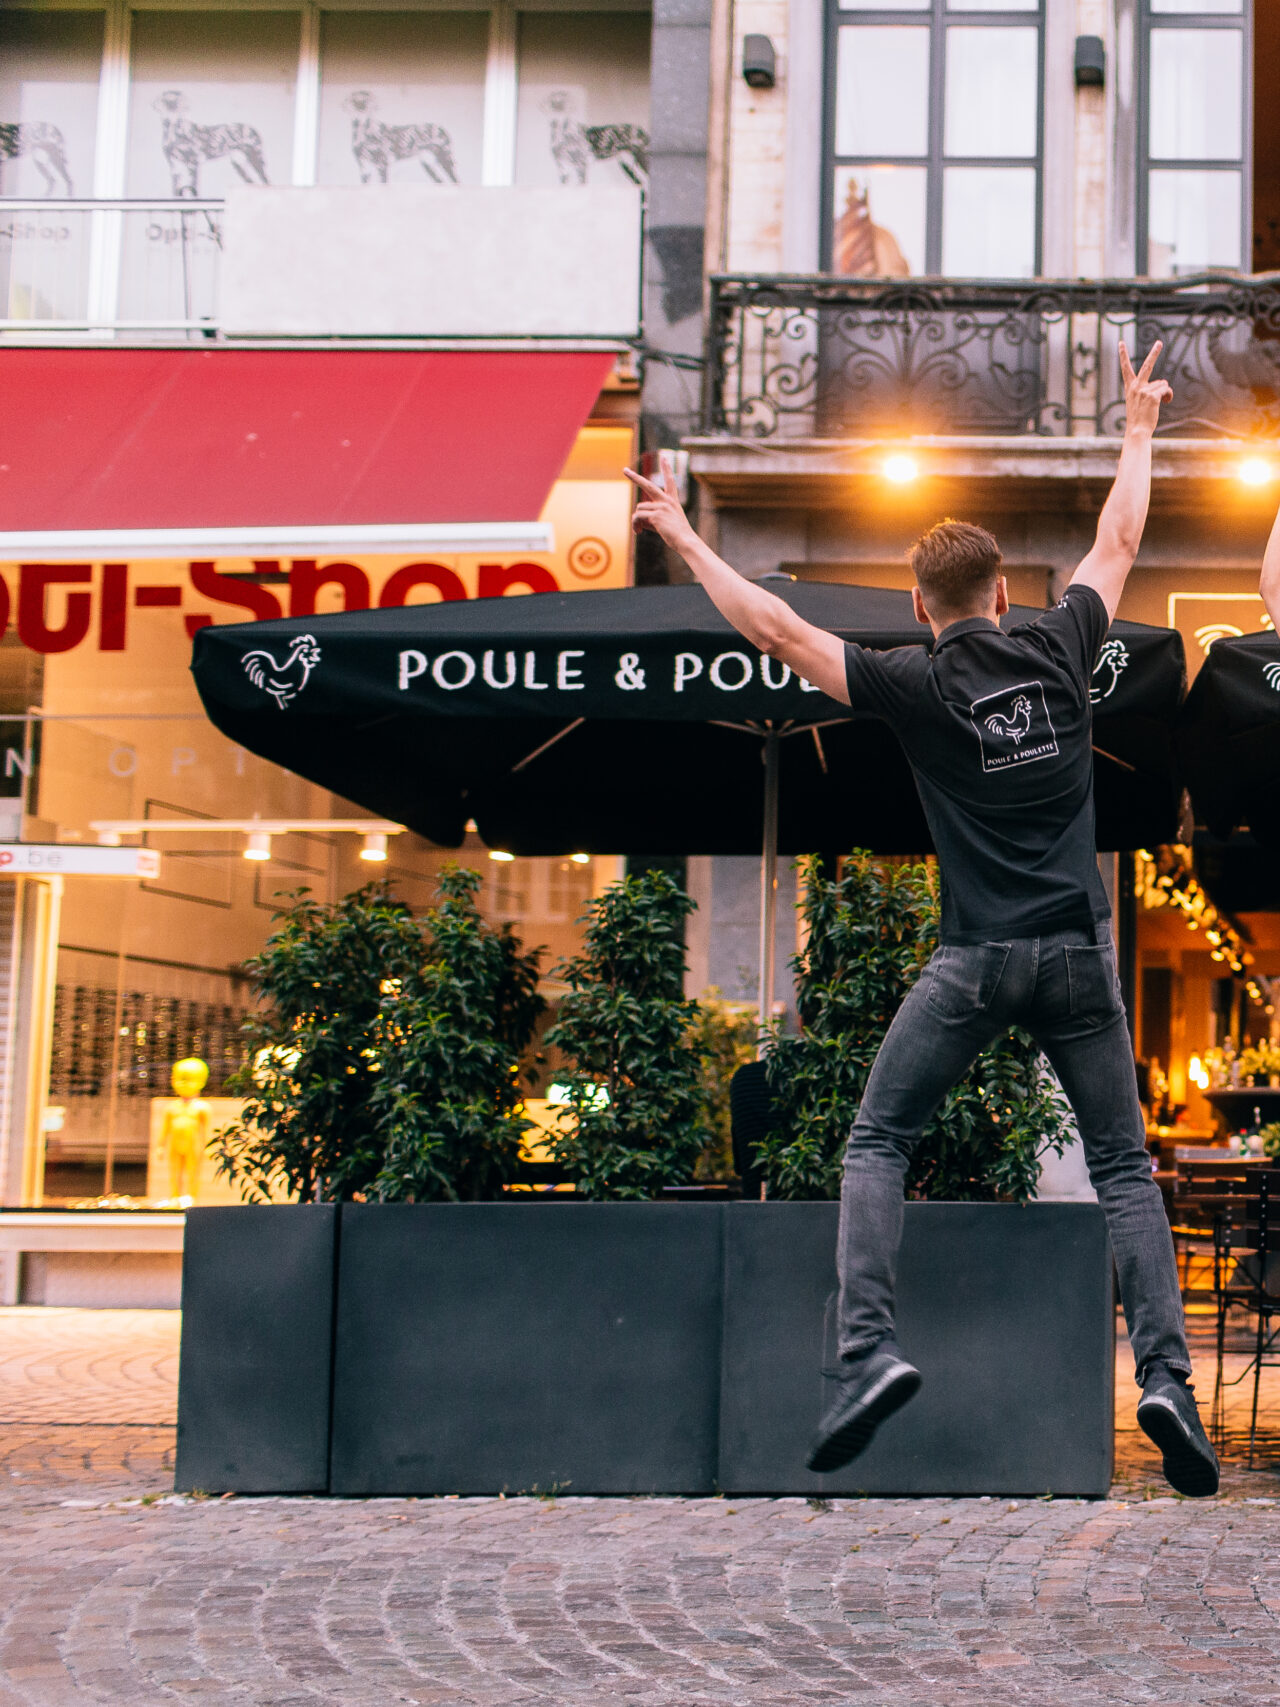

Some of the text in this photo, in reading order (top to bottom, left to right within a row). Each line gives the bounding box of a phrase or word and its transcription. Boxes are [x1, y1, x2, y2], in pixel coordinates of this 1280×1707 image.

[399, 649, 822, 692] POULE & POU
[108, 747, 292, 778] OPT
[1020, 743, 1053, 758] POULETTE
